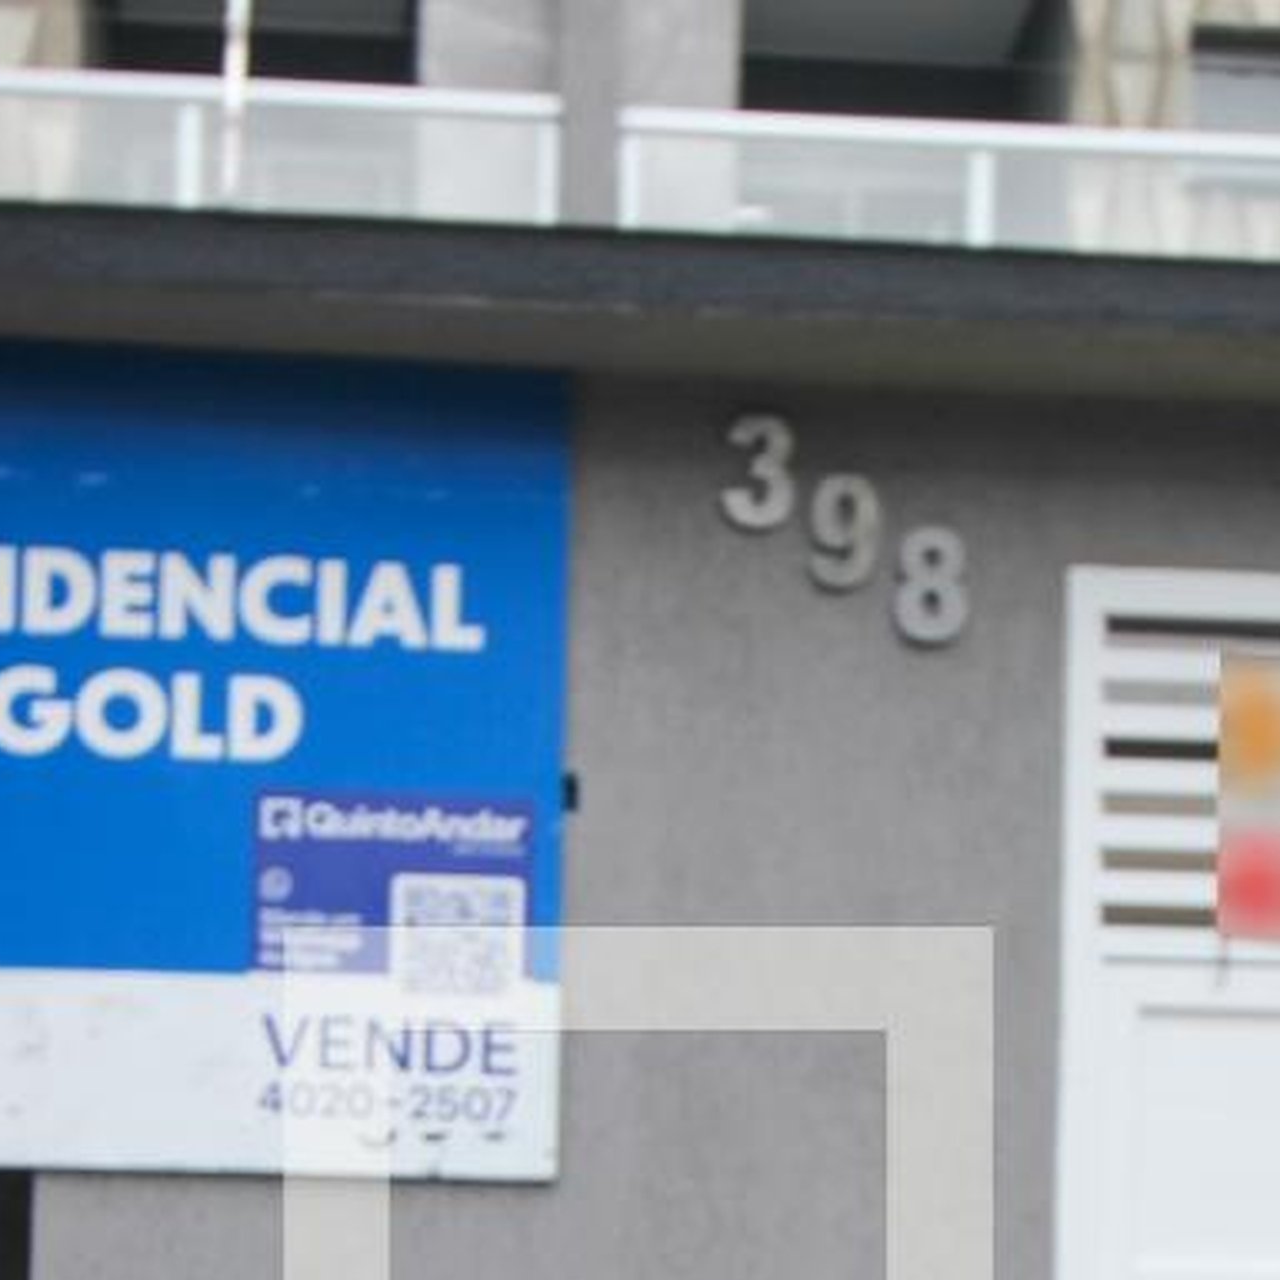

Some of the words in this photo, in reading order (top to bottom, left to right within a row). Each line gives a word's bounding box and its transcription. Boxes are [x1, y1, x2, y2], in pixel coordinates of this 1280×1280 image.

[721, 413, 968, 643] 398
[305, 799, 528, 842] QuintoAndar
[260, 1012, 519, 1076] VENDE
